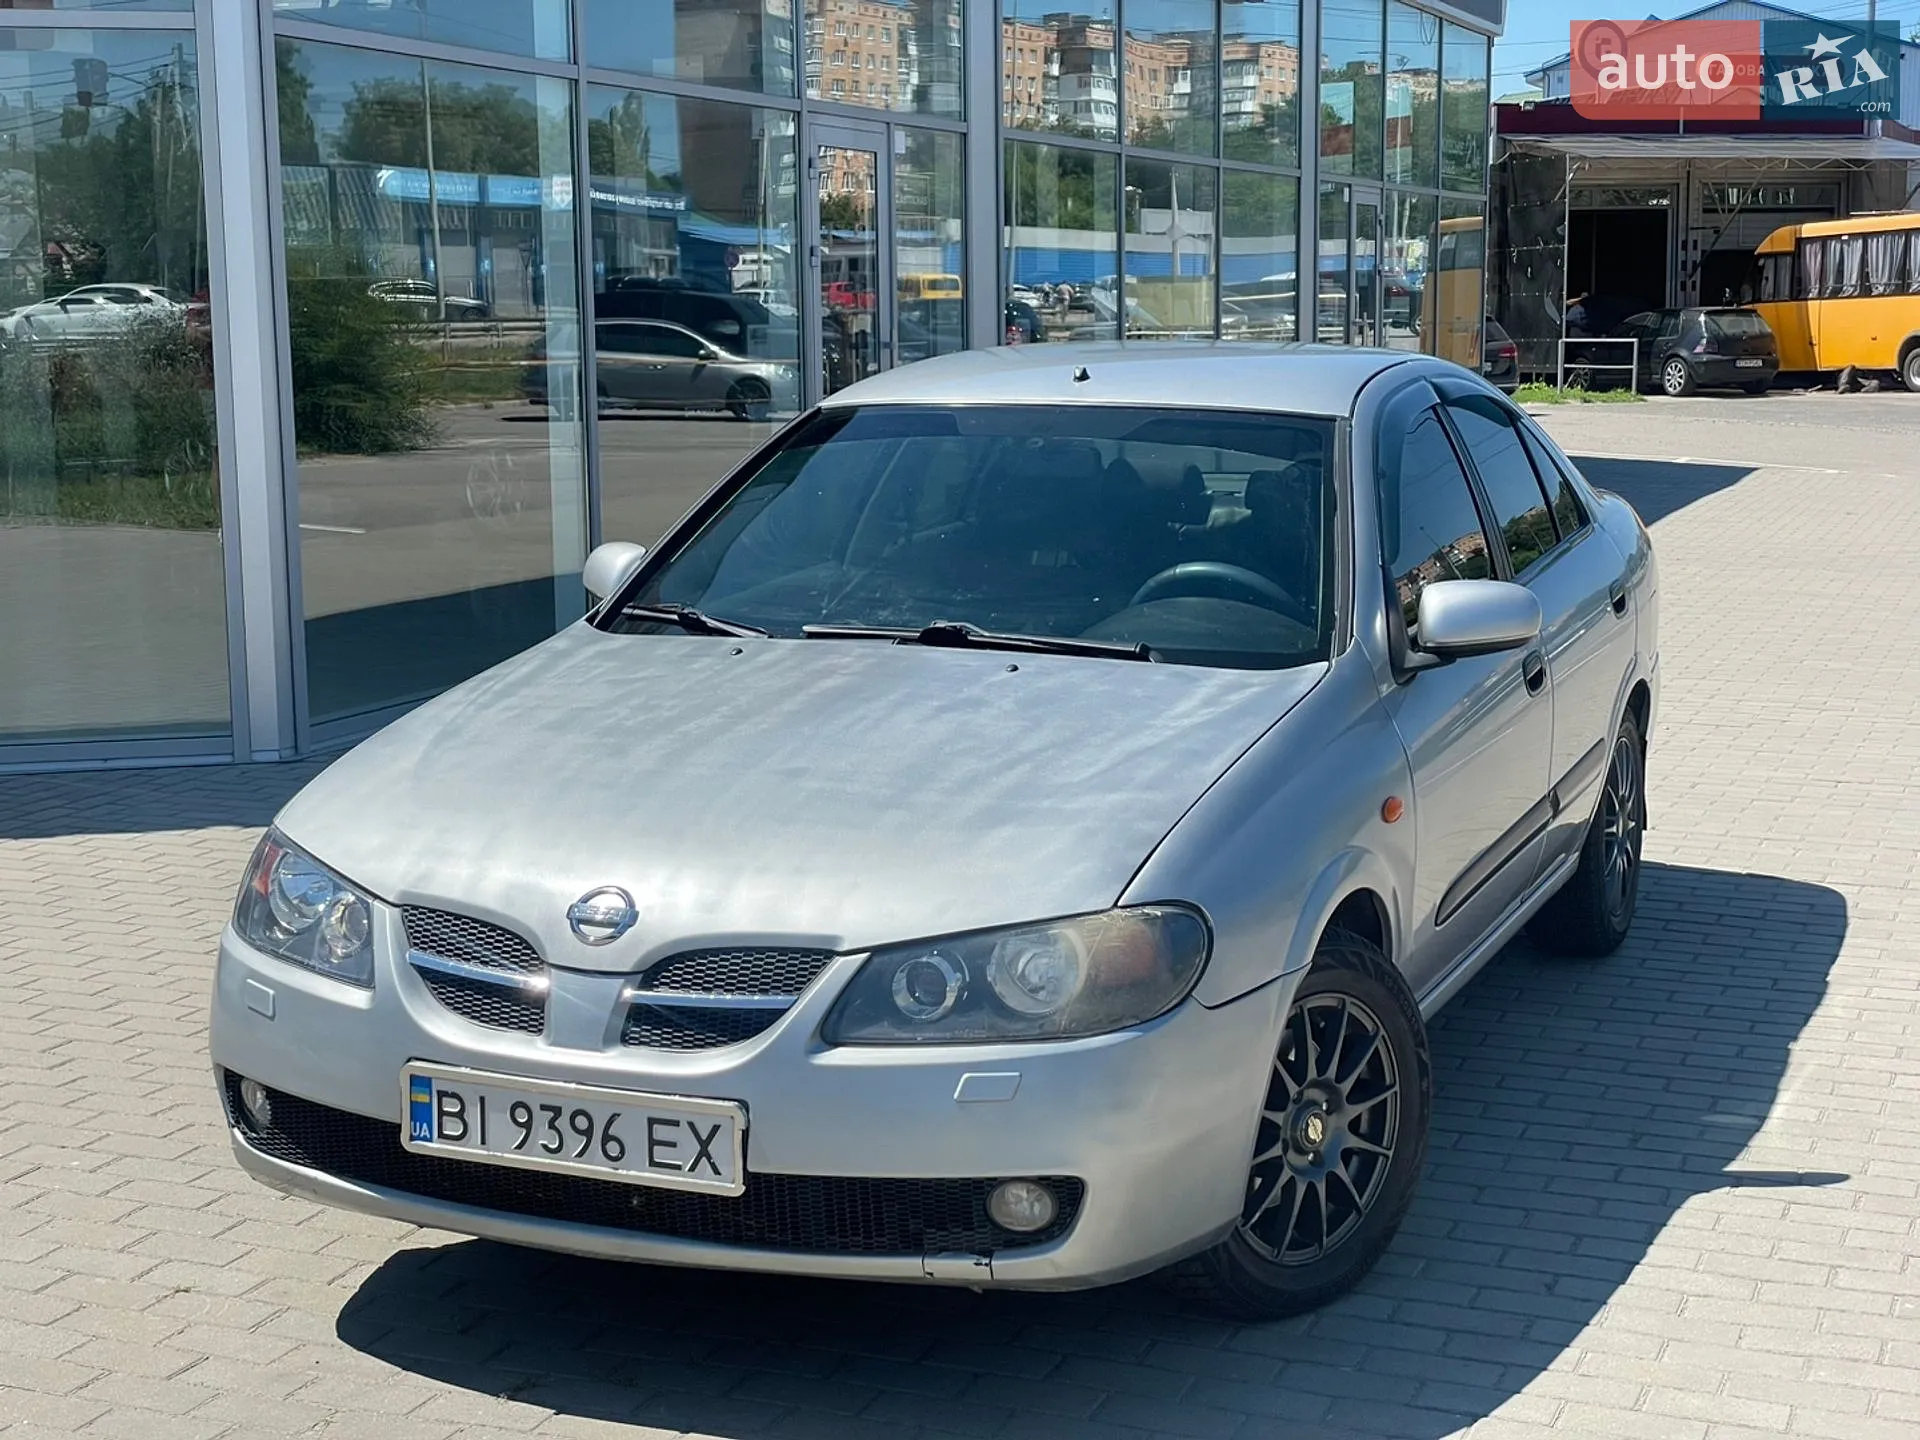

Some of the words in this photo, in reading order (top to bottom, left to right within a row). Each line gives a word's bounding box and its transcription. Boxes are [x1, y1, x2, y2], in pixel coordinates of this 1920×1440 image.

[411, 1121, 431, 1140] UA
[435, 1089, 486, 1146] BI
[508, 1100, 627, 1163] 9396
[646, 1116, 723, 1177] EX
